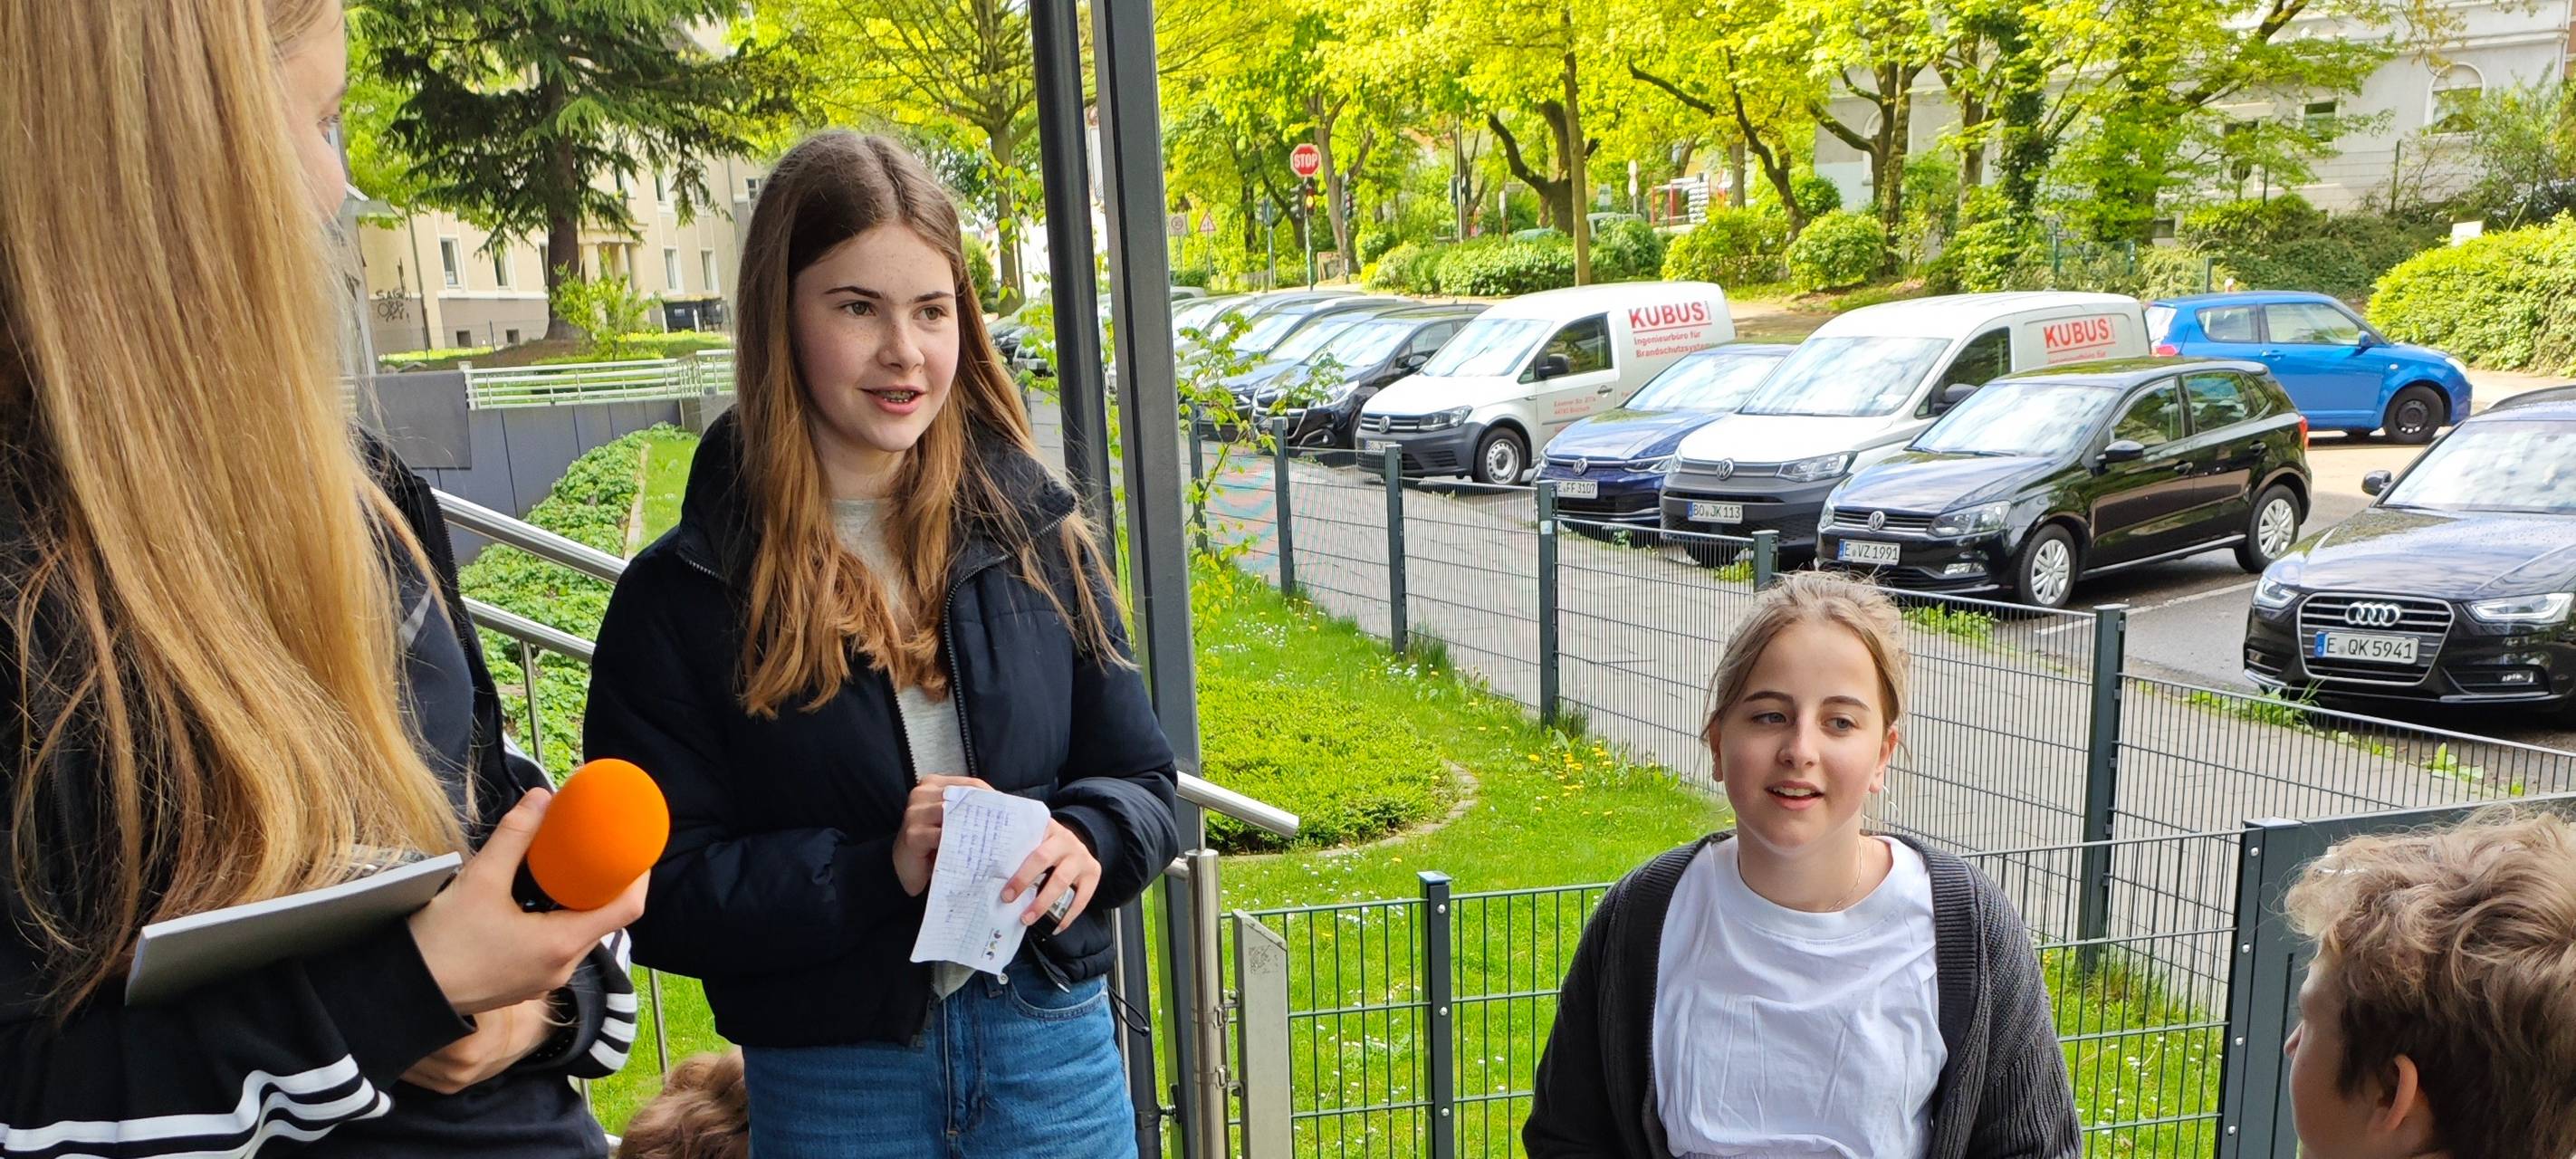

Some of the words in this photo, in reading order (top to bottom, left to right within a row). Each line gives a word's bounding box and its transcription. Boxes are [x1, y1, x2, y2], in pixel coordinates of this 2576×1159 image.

[1294, 153, 1318, 168] STOP
[1628, 302, 1704, 329] KUBUS
[2043, 318, 2109, 349] KUBUS
[1566, 482, 1576, 493] FF
[1577, 483, 1595, 494] 3107
[1693, 503, 1705, 516] BO
[1710, 505, 1721, 517] JK
[1723, 506, 1740, 519] 113
[1844, 543, 1851, 557] E
[1858, 544, 1871, 559] VZ
[1872, 546, 1899, 560] 1991
[2327, 637, 2337, 654] E
[2348, 639, 2370, 656] QK
[2371, 641, 2413, 659] 5941
